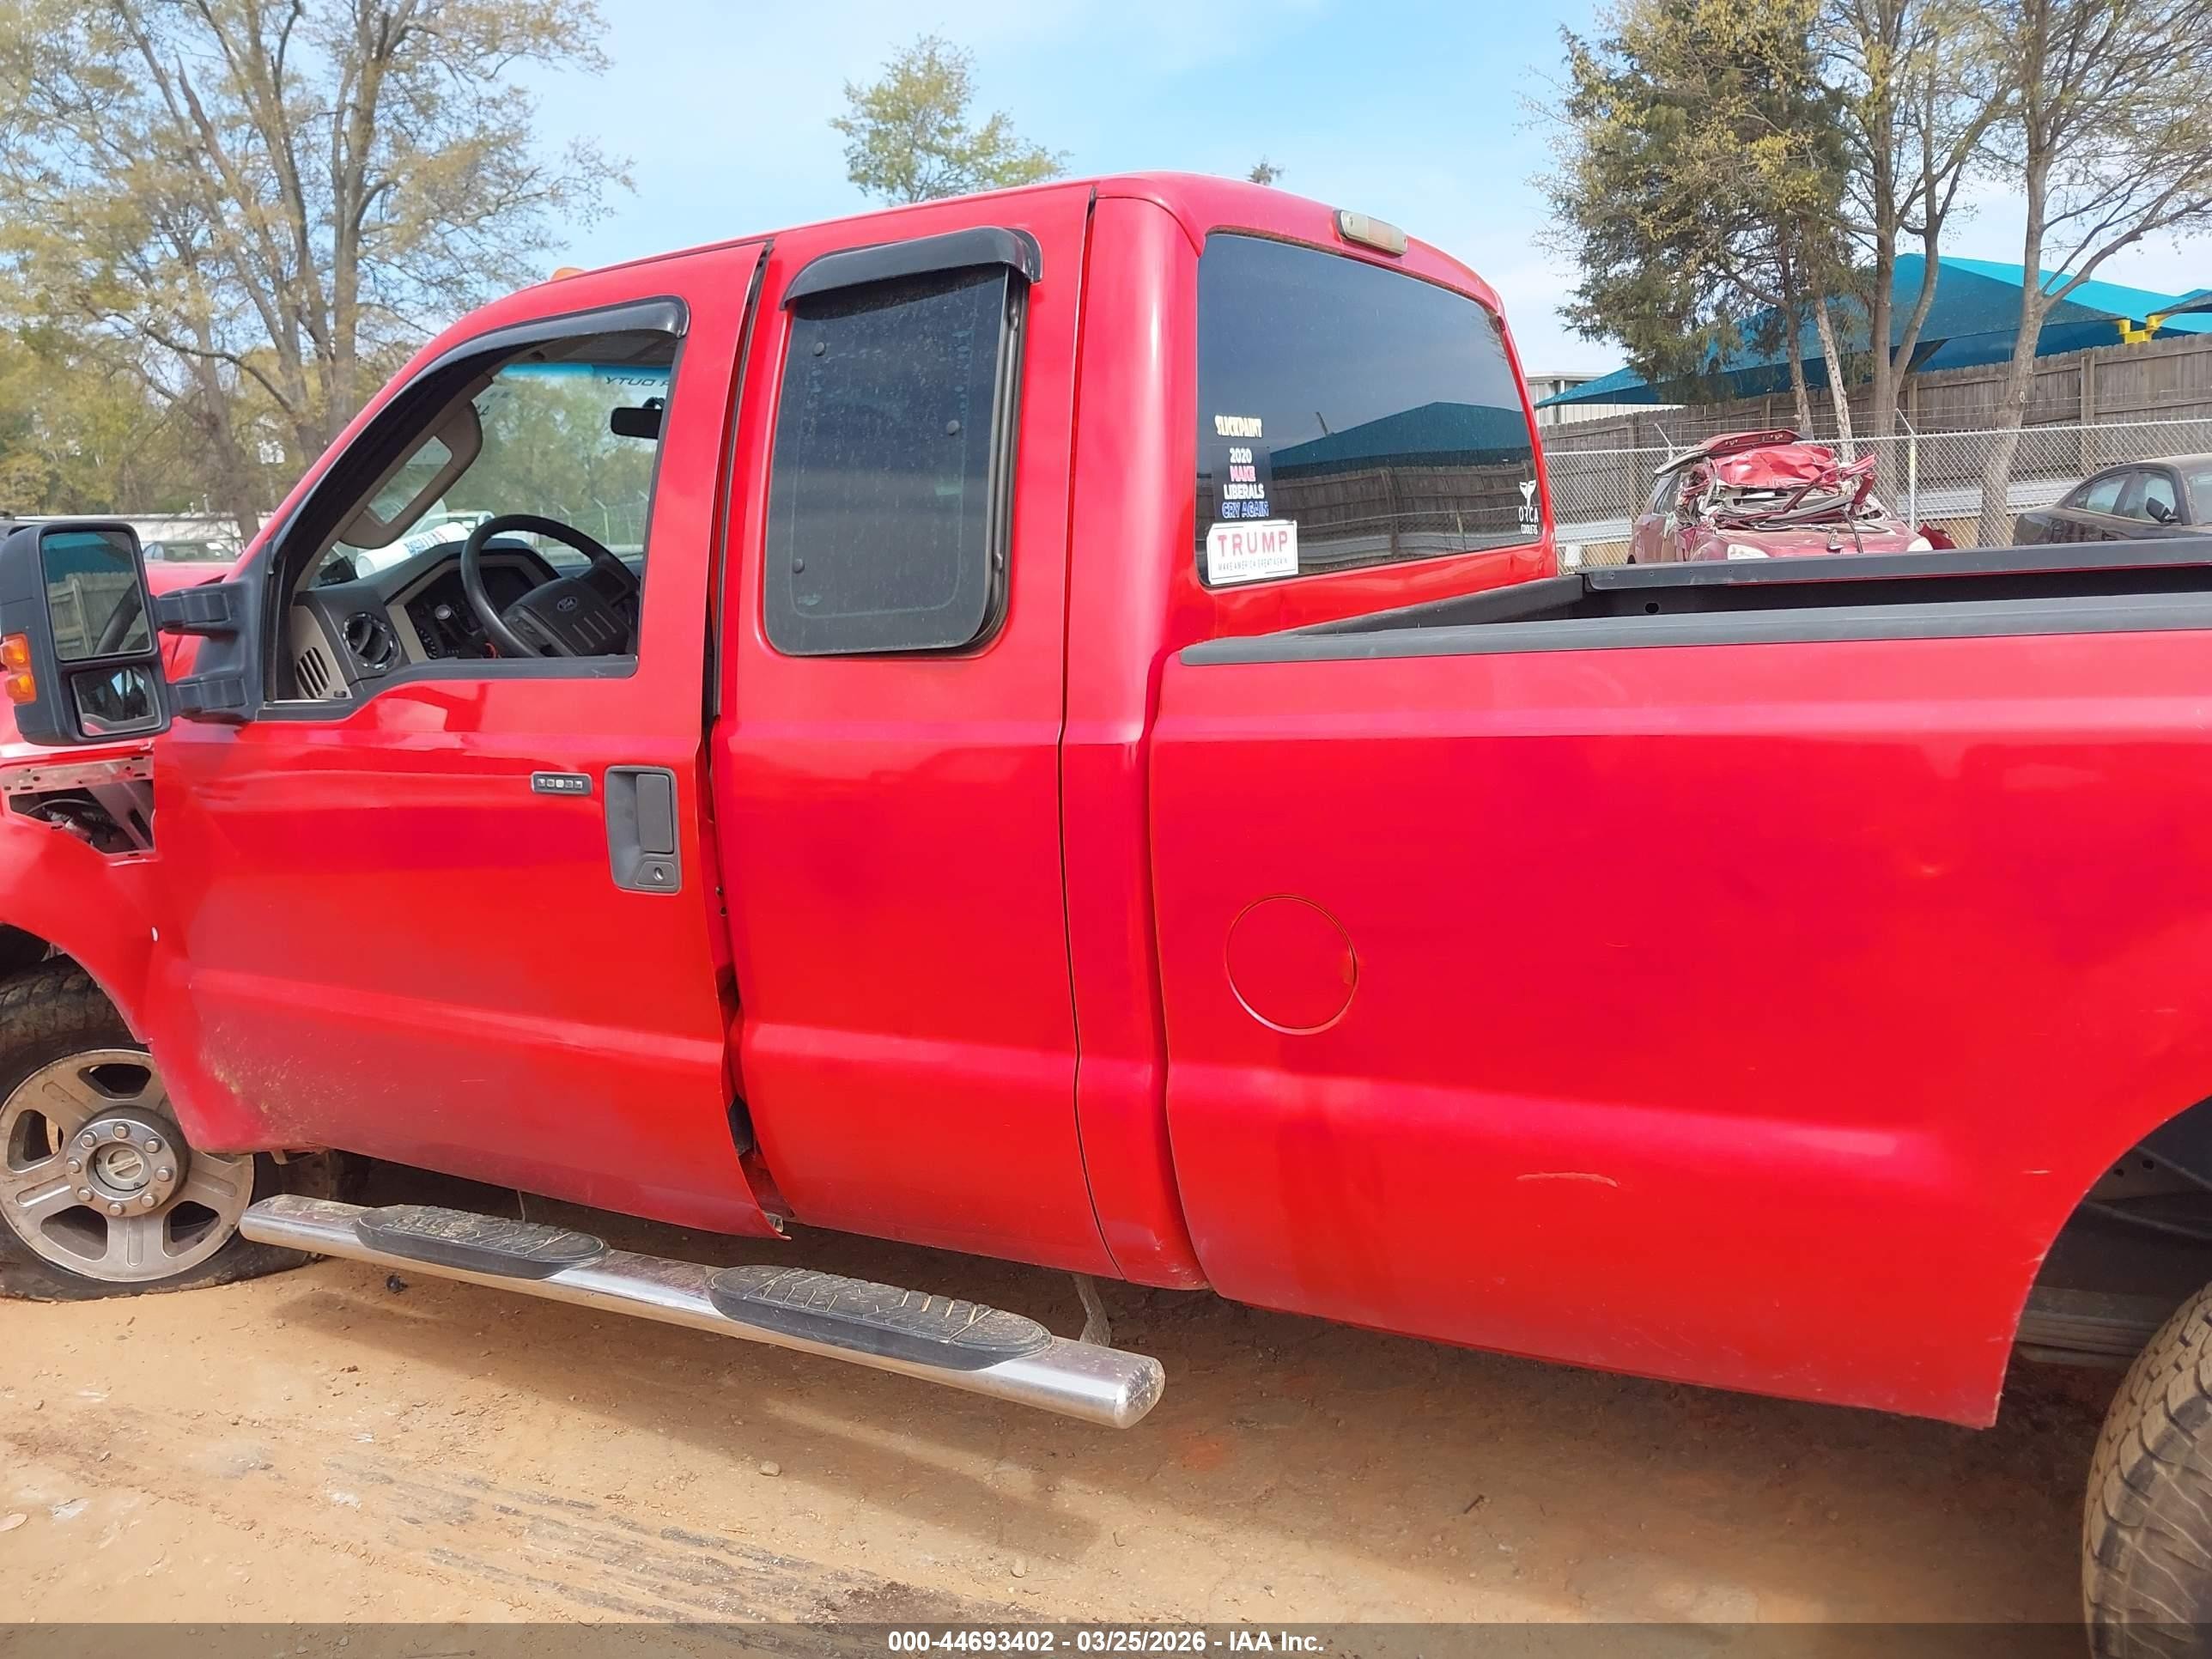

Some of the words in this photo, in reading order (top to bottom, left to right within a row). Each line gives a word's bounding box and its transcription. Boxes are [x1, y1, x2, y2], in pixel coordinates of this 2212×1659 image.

[1229, 447, 1253, 464] 2020
[1229, 465, 1256, 482] MAKE
[1223, 483, 1265, 500] LIBERALS
[1222, 501, 1240, 519] CRY
[1242, 501, 1270, 518] AGAIN
[1518, 506, 1539, 523] ORCA
[1217, 530, 1288, 557] TRUMP
